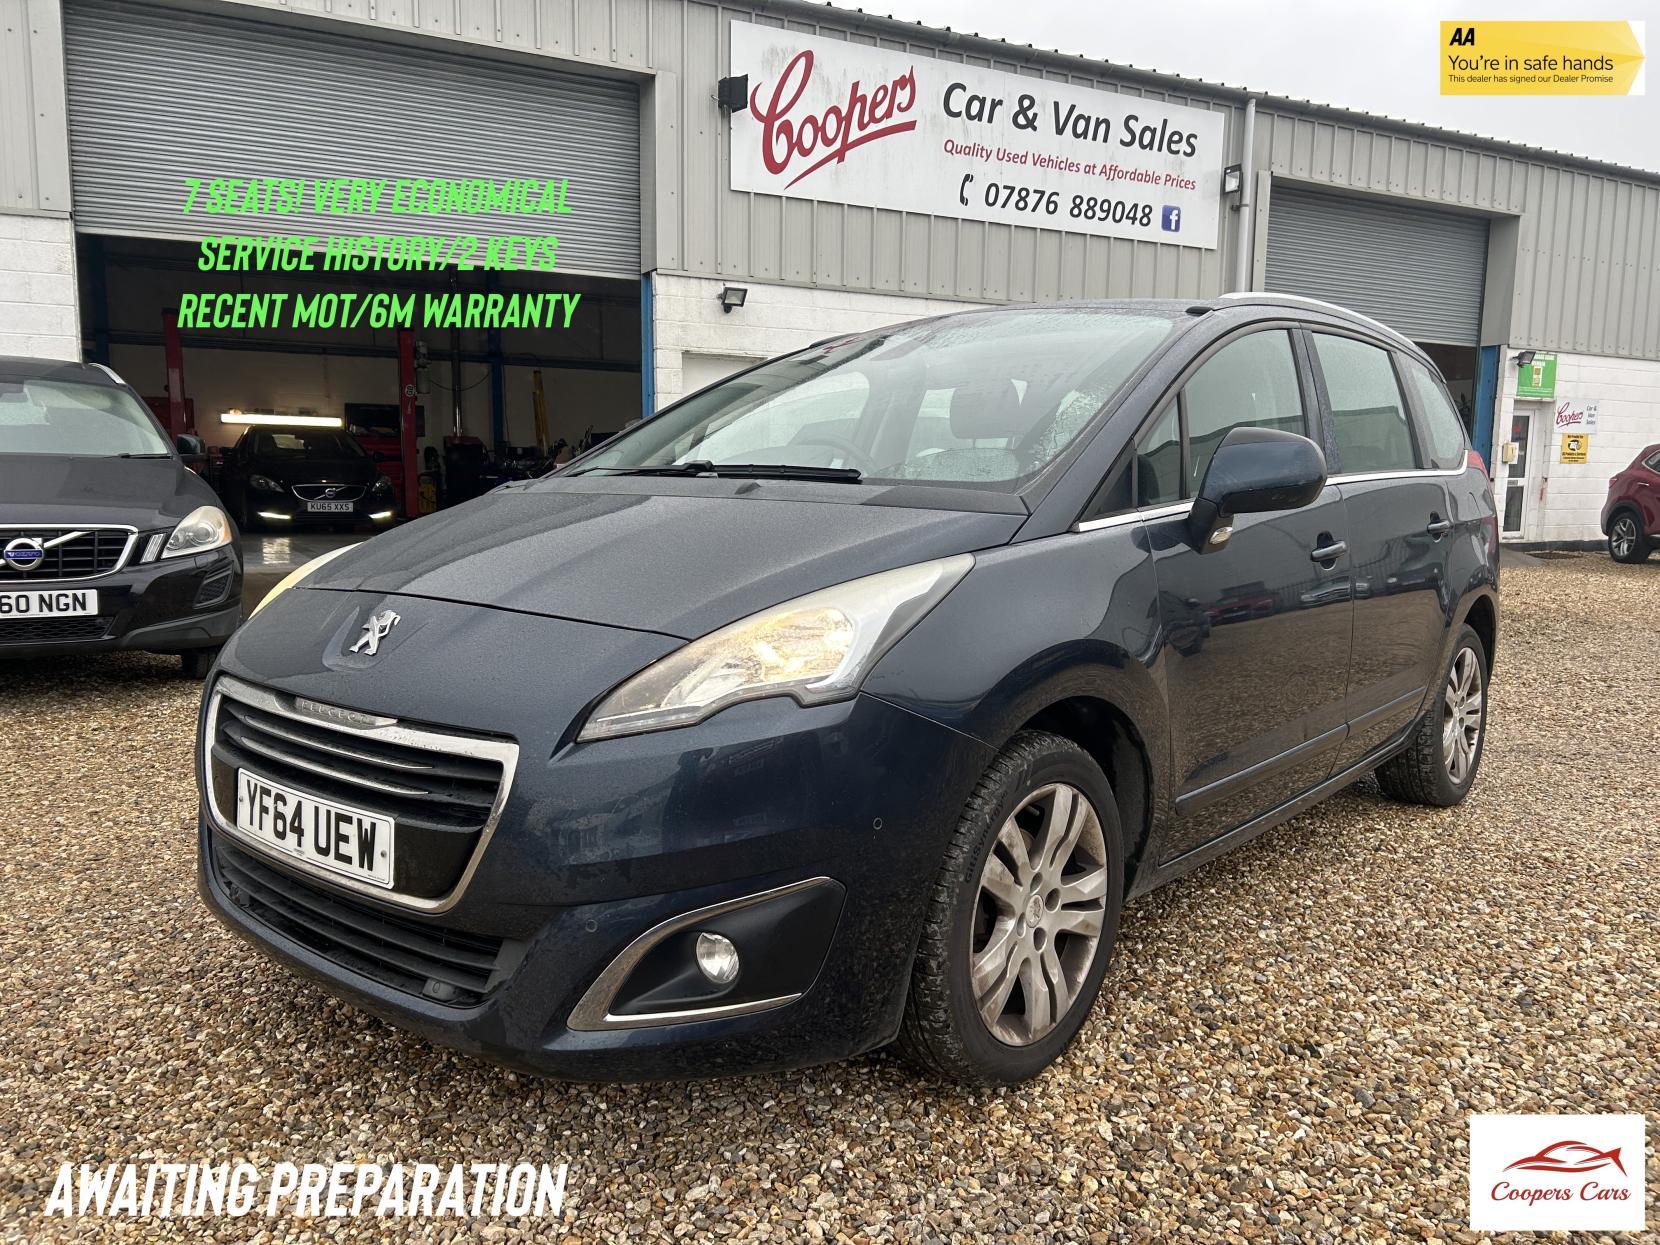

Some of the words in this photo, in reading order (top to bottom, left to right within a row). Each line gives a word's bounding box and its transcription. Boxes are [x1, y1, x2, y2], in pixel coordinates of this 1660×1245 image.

[750, 50, 917, 175] Coopers
[942, 82, 1004, 125] Car
[1011, 92, 1039, 131] &
[1052, 100, 1111, 144] Van
[1120, 113, 1198, 158] Sales
[943, 138, 993, 163] Quality
[996, 147, 1028, 167] Used
[1031, 152, 1081, 174] Vehicles
[1083, 162, 1097, 176] at
[1098, 163, 1161, 185] Affordable
[1164, 171, 1196, 191] Prices
[984, 182, 1059, 215] 07876
[1069, 194, 1152, 227] 889048
[1556, 402, 1583, 426] Coopers
[310, 503, 331, 511] KU65
[334, 503, 350, 511] XXS
[38, 592, 87, 613] NGN
[246, 779, 304, 848] YF64
[313, 805, 376, 872] UEW
